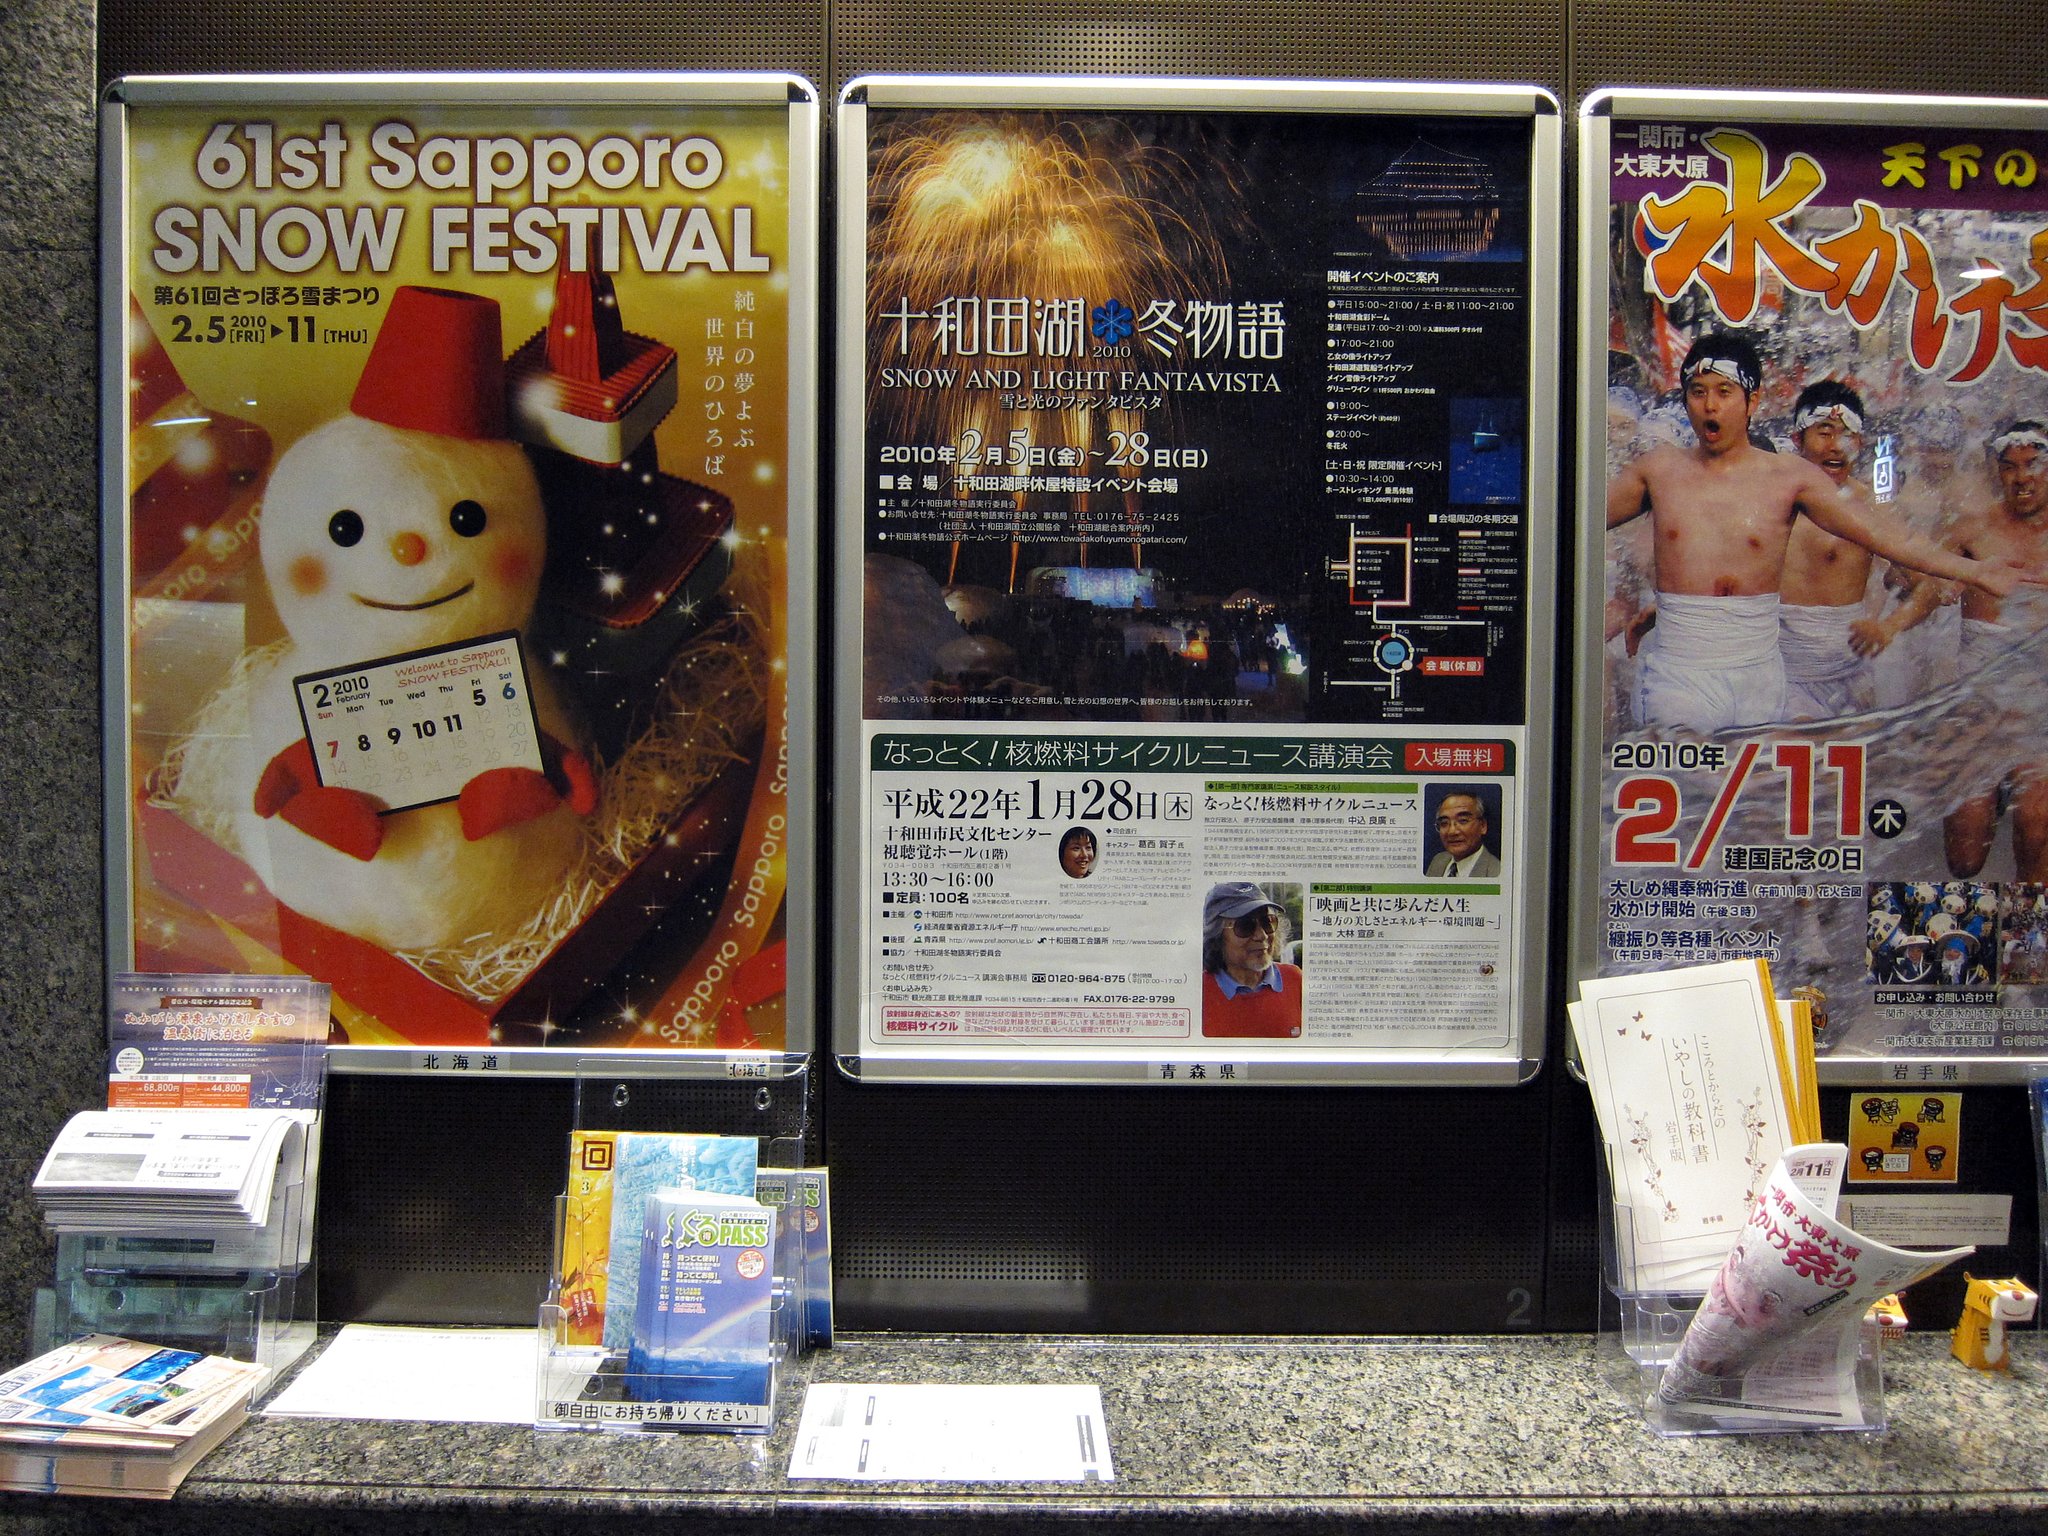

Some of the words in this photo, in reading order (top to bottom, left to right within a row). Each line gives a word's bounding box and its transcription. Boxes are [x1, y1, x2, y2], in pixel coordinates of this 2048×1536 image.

[195, 124, 349, 190] 61st
[371, 124, 723, 203] Sapporo
[1614, 153, 1708, 178] 大東大原
[1882, 142, 2037, 189] 天下の
[153, 206, 404, 273] SNOW
[433, 208, 771, 273] FESTIVAL
[1327, 271, 1438, 283] 開催イベントのご案内
[153, 287, 379, 306] 第61回さっぽろ雪まつり
[172, 316, 225, 343] 2.5
[231, 315, 267, 328] 2010
[287, 316, 317, 342] 11
[879, 296, 1085, 358] 十和田湖
[1093, 345, 1130, 358] 2010
[1138, 298, 1286, 359] 冬物語
[230, 329, 266, 343] [FRI]
[323, 329, 368, 343] [THU]
[733, 290, 755, 448] 純白の夢よぶ
[881, 369, 958, 389] SNOW
[965, 370, 1021, 389] AND
[1032, 371, 1110, 390] LIGHT
[1120, 372, 1281, 392] FANTAVISTA
[705, 317, 725, 476] 世界のひろば
[1000, 394, 1162, 410] 雪と光のファンタビスタ
[1043, 513, 1068, 521] 事務局
[1439, 515, 1518, 523] 会場周辺の冬期交通
[395, 659, 445, 677] Welcome
[447, 657, 458, 666] to
[462, 648, 505, 666] Sapporo
[398, 673, 439, 687] SNOW
[313, 684, 332, 708] 2
[333, 677, 369, 695] 2010
[318, 711, 333, 719] Sun
[346, 704, 364, 714] Mon
[379, 698, 393, 706] Tue
[407, 691, 426, 700] Wed
[439, 685, 453, 693] Thu
[499, 672, 512, 680] Sat
[336, 691, 370, 704] February
[473, 690, 486, 706] 5
[502, 683, 516, 699] 6
[327, 741, 338, 758] 7
[358, 735, 370, 751] 8
[388, 728, 400, 745] 9
[413, 720, 436, 738] 10
[444, 714, 462, 731] 11
[1415, 748, 1492, 767] 入場無料
[1613, 744, 1725, 771] 2010年
[882, 779, 1156, 820] 平成22年1月28日
[1611, 741, 1866, 872] 2/11
[1348, 816, 1365, 825] 中込
[883, 827, 1052, 842] 十和田市民文化センター
[1724, 847, 1862, 871] 建国記念の日
[734, 814, 785, 927] Sapporo
[1610, 880, 1748, 897] 大しめ縄奉納行進
[1818, 885, 1862, 897] 花火合図
[924, 910, 954, 919] 十和田市
[1609, 901, 1696, 918] 水かけ開始
[924, 923, 1018, 931] 経済産業省資源エネルギー庁
[1337, 929, 1354, 938] 大林
[924, 936, 946, 944] 青森県
[1048, 937, 1109, 945] 十和田商工会議所
[914, 949, 1001, 957] 十和田湖冬物語実行委員会
[1048, 974, 1125, 983] 0120-964-875
[661, 939, 738, 1043] Sapporo
[1084, 995, 1175, 1004] FAX.0176-22-9799
[1876, 992, 1995, 1004] お申し込み・お問い合わせ
[125, 1012, 295, 1025] ぬかびら源泉かけ流し宣言の
[887, 1021, 958, 1032] 核燃料サイクル
[163, 1027, 254, 1040] 温泉街に泊まる
[424, 1054, 498, 1070] 北海道
[1160, 1063, 1234, 1080] 青森県
[1894, 1064, 1958, 1079] 岩手県
[1701, 1034, 1725, 1128] こころとからだの
[1673, 1037, 1709, 1163] いやしの教科書
[1665, 1122, 1683, 1161] 岩手版
[720, 1225, 769, 1247] PASS
[554, 1402, 749, 1423] 御自由にお持ち帰りください
